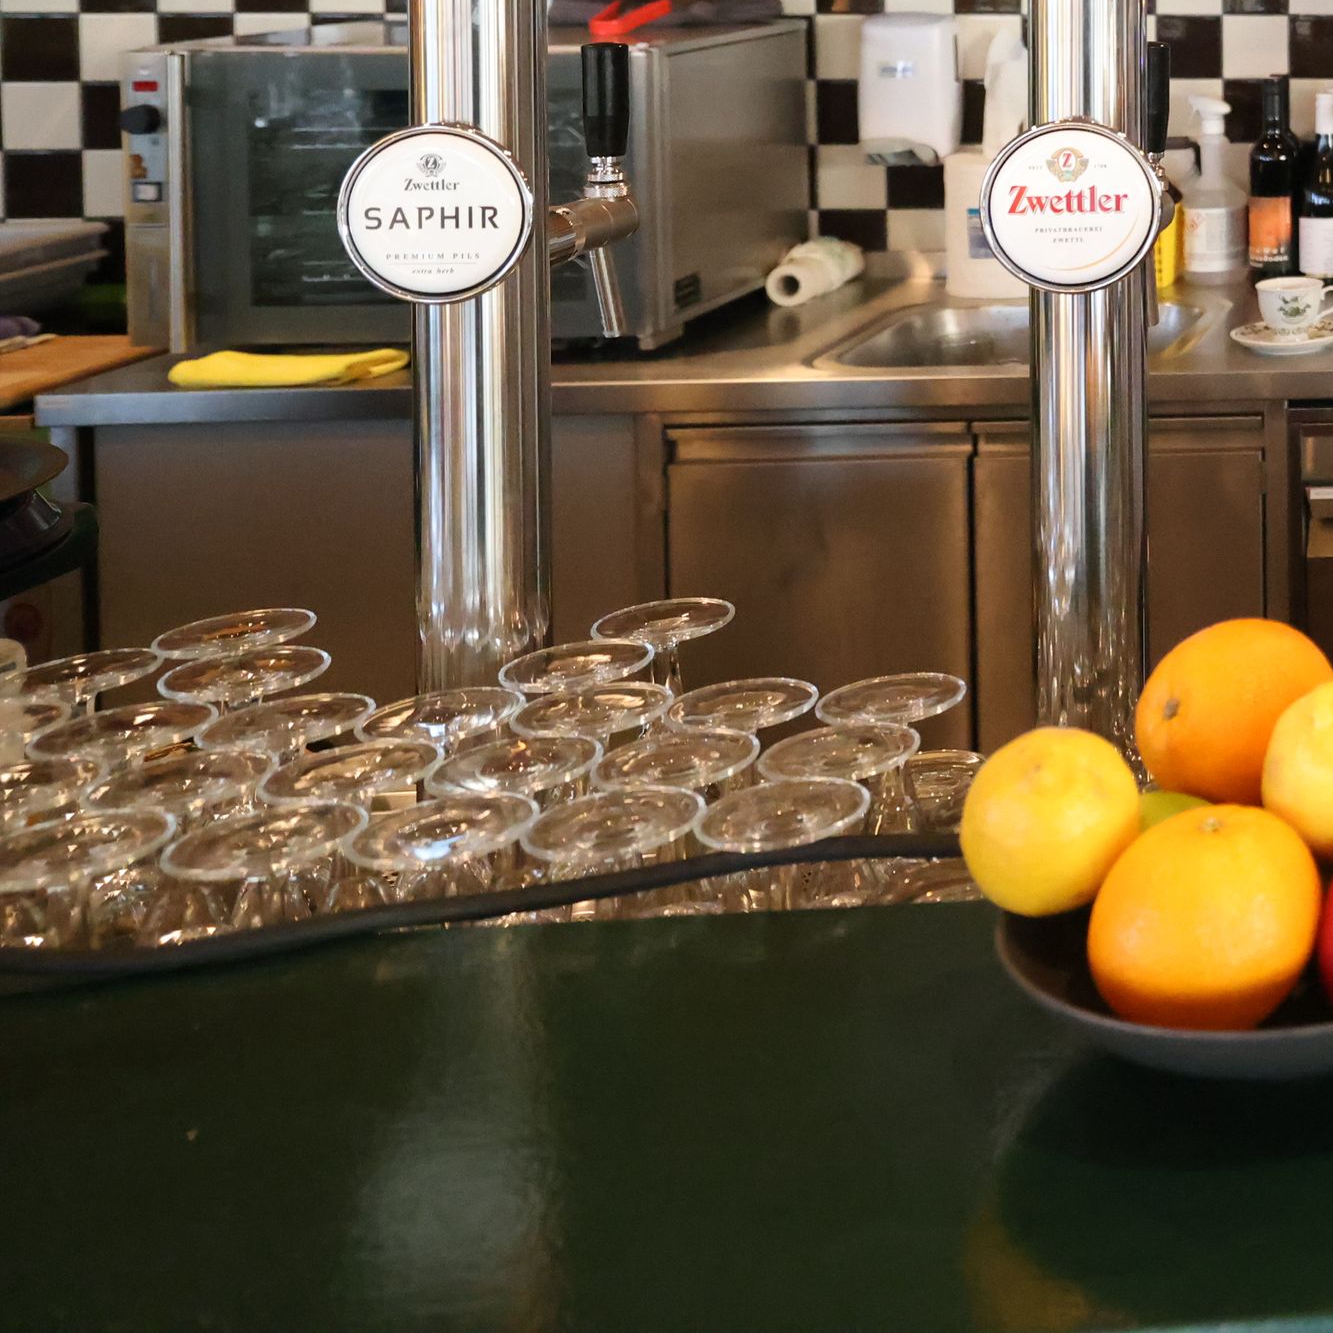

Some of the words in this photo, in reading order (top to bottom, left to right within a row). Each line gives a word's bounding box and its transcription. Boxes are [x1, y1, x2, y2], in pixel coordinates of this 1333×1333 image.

[404, 178, 460, 192] Zwettler
[1008, 185, 1129, 216] Zwettler
[364, 206, 500, 230] SAPHIR
